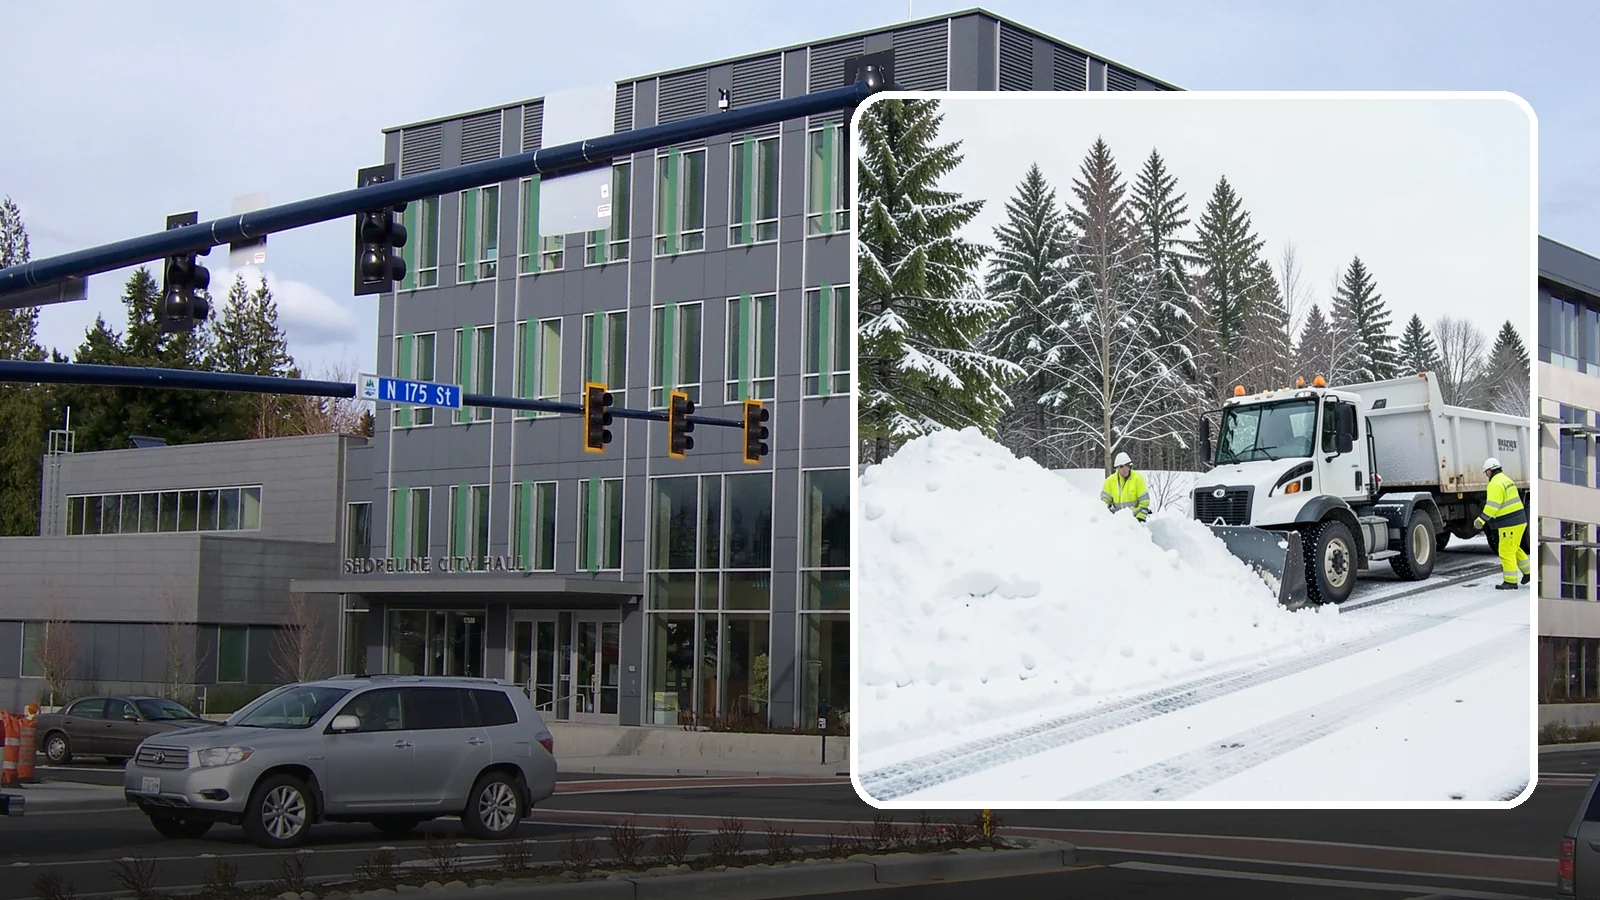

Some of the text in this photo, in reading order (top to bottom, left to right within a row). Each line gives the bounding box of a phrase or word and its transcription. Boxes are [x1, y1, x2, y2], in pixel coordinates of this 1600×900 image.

[387, 380, 451, 406] N 175 St
[344, 555, 526, 574] SHORELINE CITY HALL
